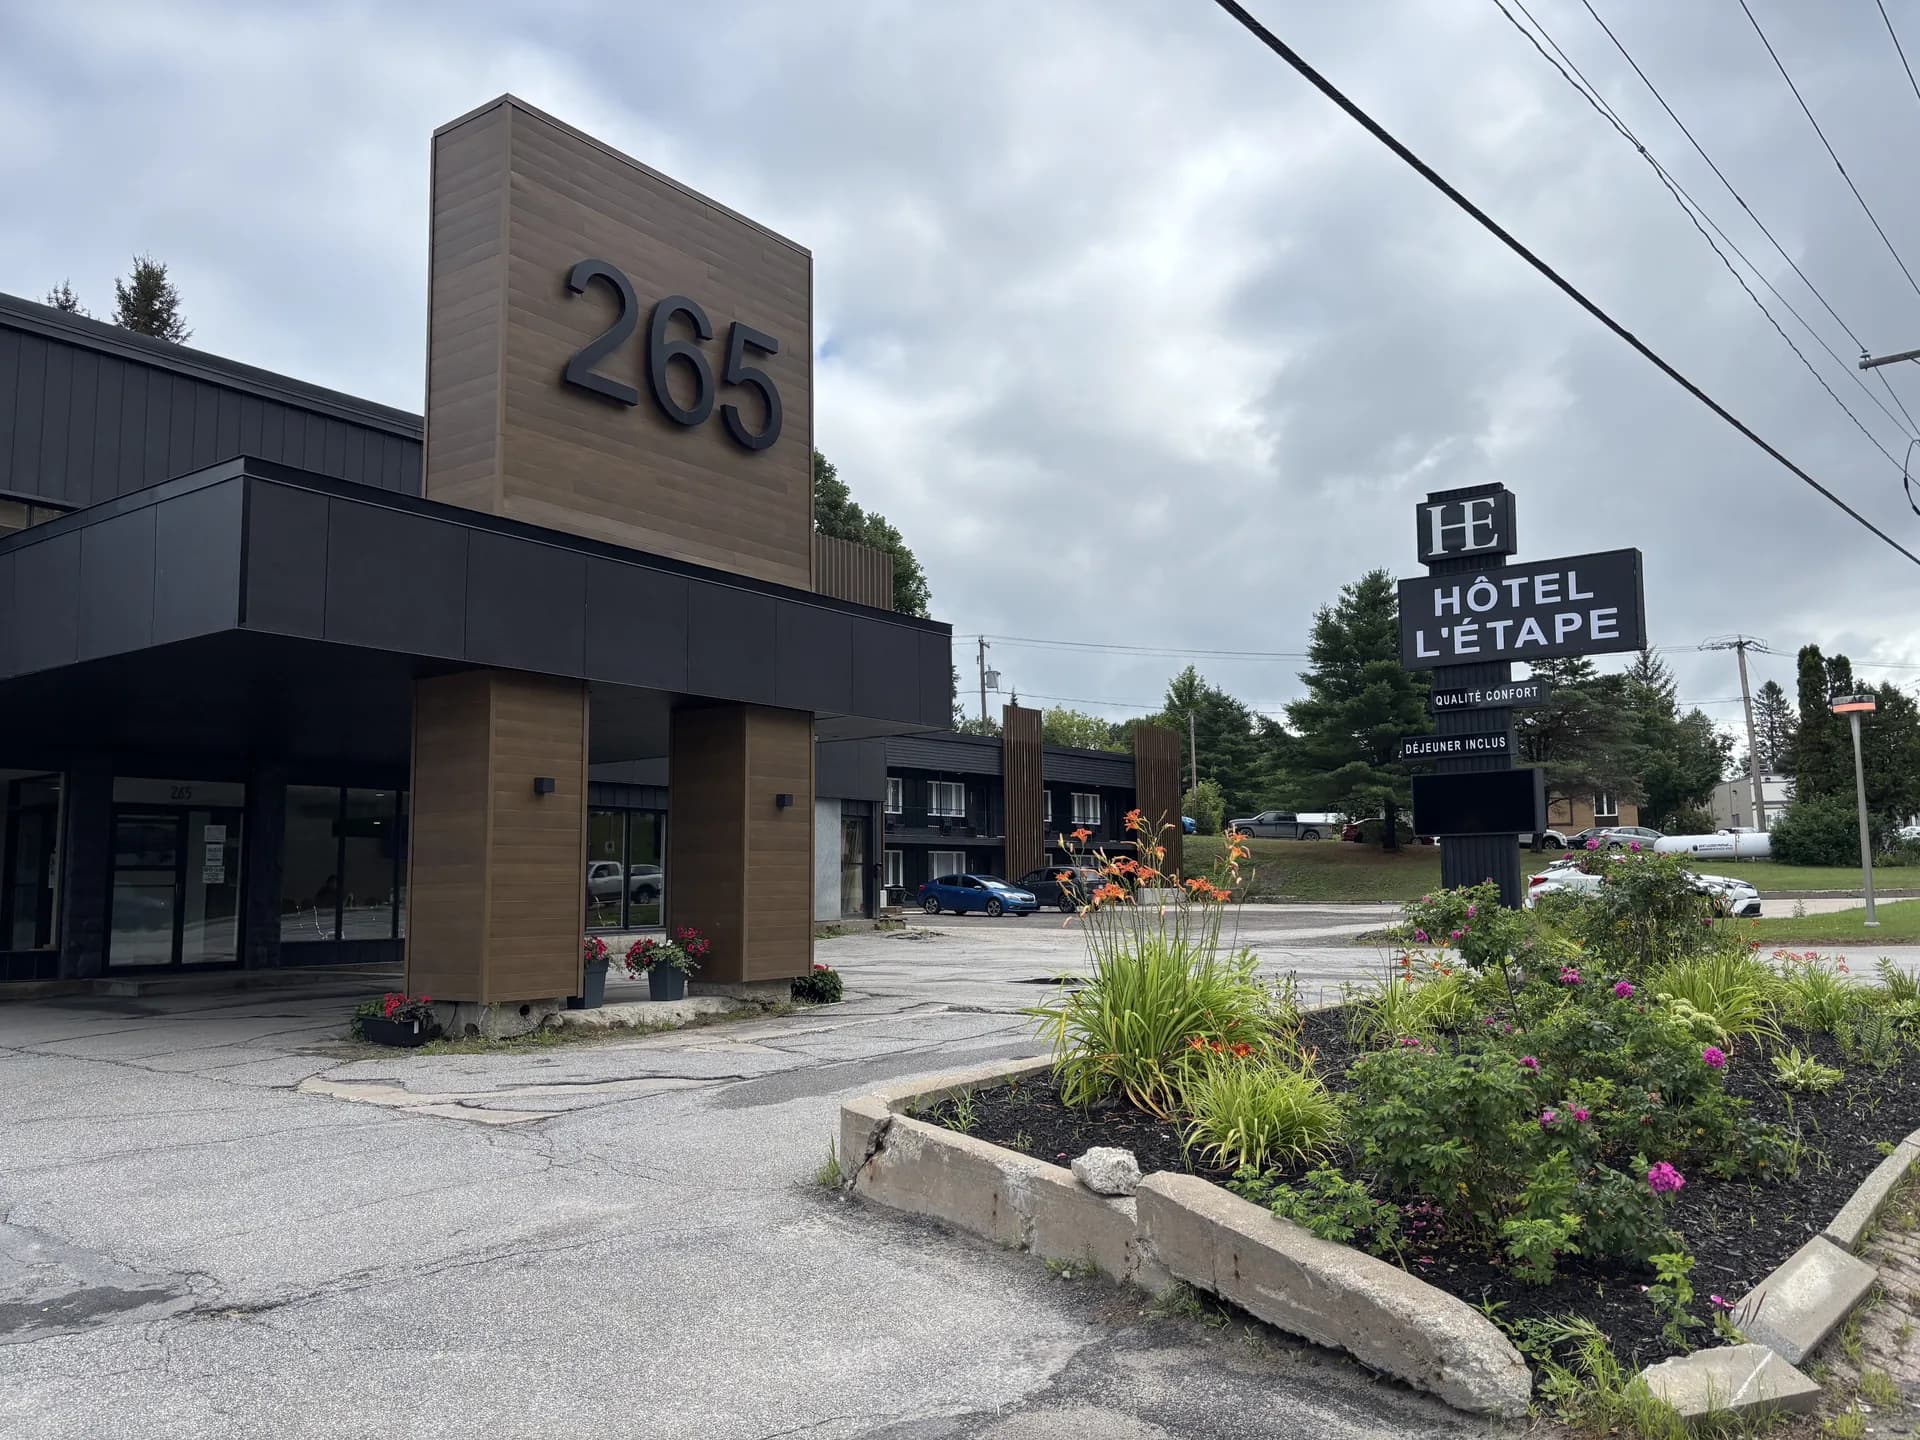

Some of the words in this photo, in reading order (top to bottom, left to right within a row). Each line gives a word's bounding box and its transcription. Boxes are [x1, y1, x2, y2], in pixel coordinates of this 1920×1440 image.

[566, 258, 783, 450] 265
[1426, 497, 1498, 556] HE
[1434, 570, 1594, 617] HÔTEL
[1416, 607, 1620, 658] L'ÉTAPE
[1435, 689, 1481, 706] QUALITÉ
[1486, 686, 1539, 702] CONFORT
[1405, 740, 1461, 755] DÉJEUNER
[1465, 736, 1506, 750] INCLUS
[170, 785, 192, 801] 265
